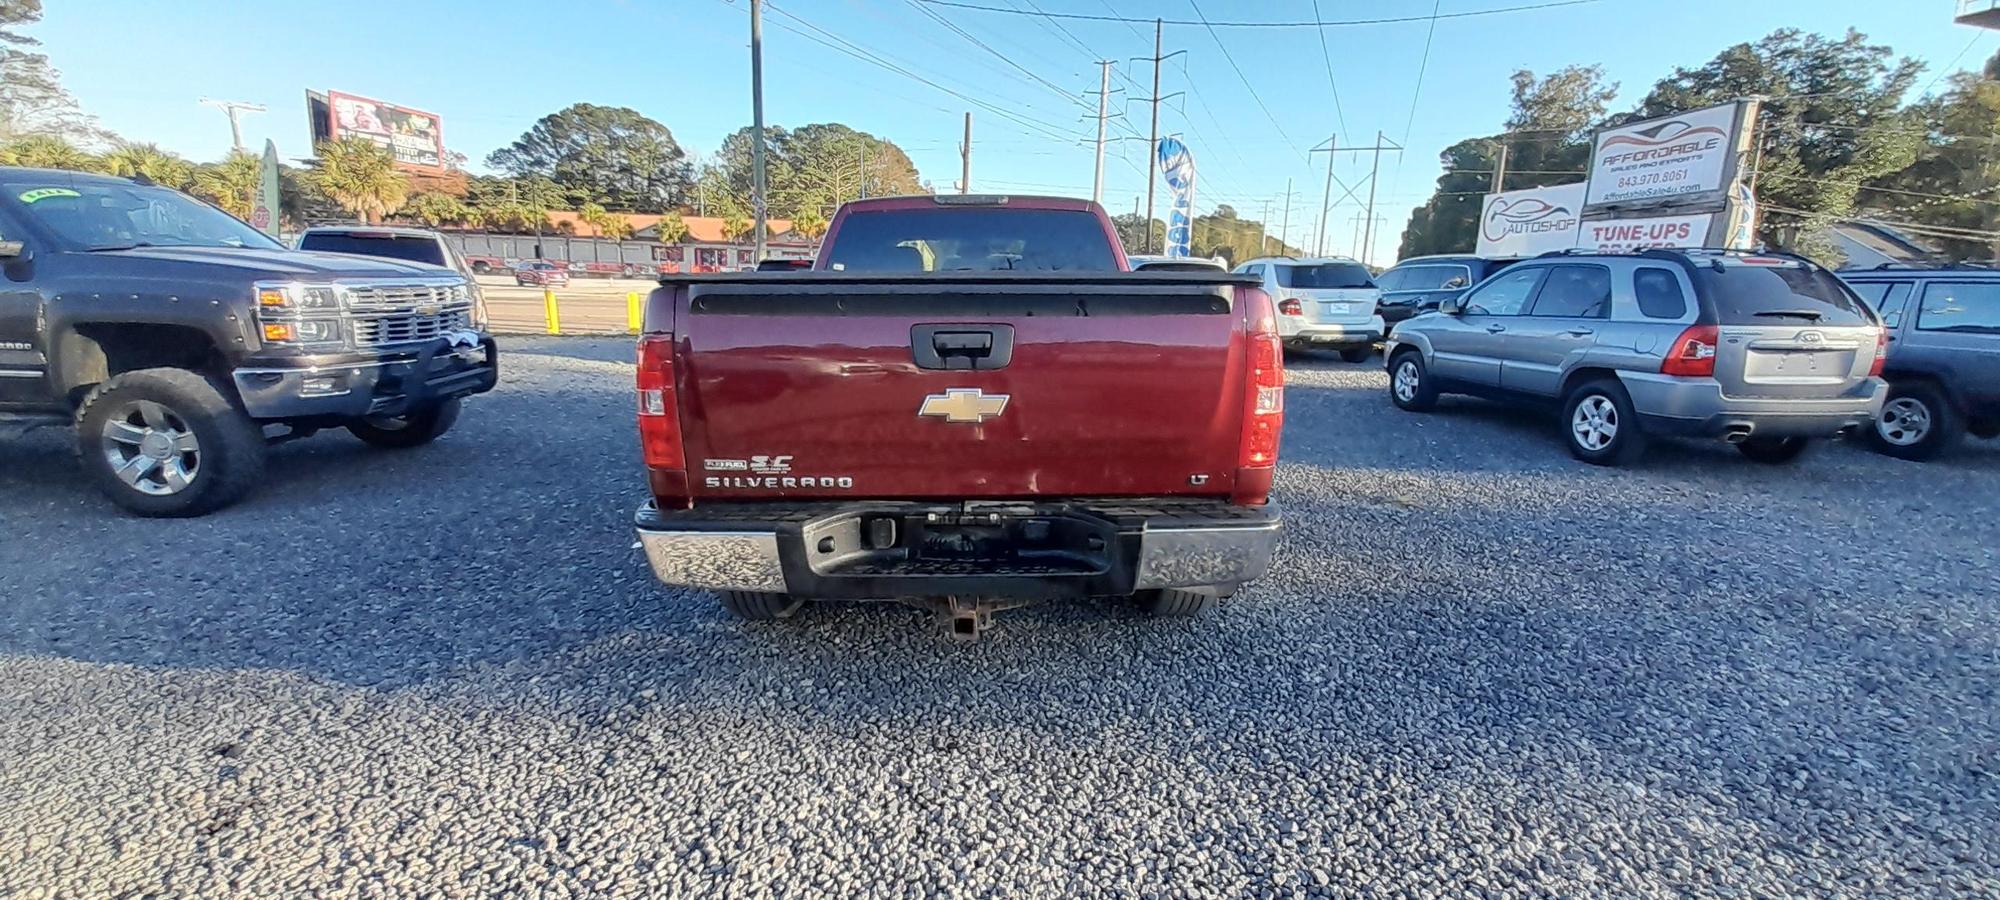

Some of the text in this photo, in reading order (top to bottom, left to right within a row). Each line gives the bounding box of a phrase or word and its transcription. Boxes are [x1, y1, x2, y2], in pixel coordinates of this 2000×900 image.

[1602, 138, 1718, 166] AFFORDABLE
[1639, 160, 1658, 169] AND
[1658, 154, 1703, 166] EXPORTS
[1507, 219, 1577, 234] AUTOSHOP
[1592, 222, 1690, 241] TUNE-UPS
[705, 477, 853, 488] SILVERADO
[1190, 474, 1209, 485] LT
